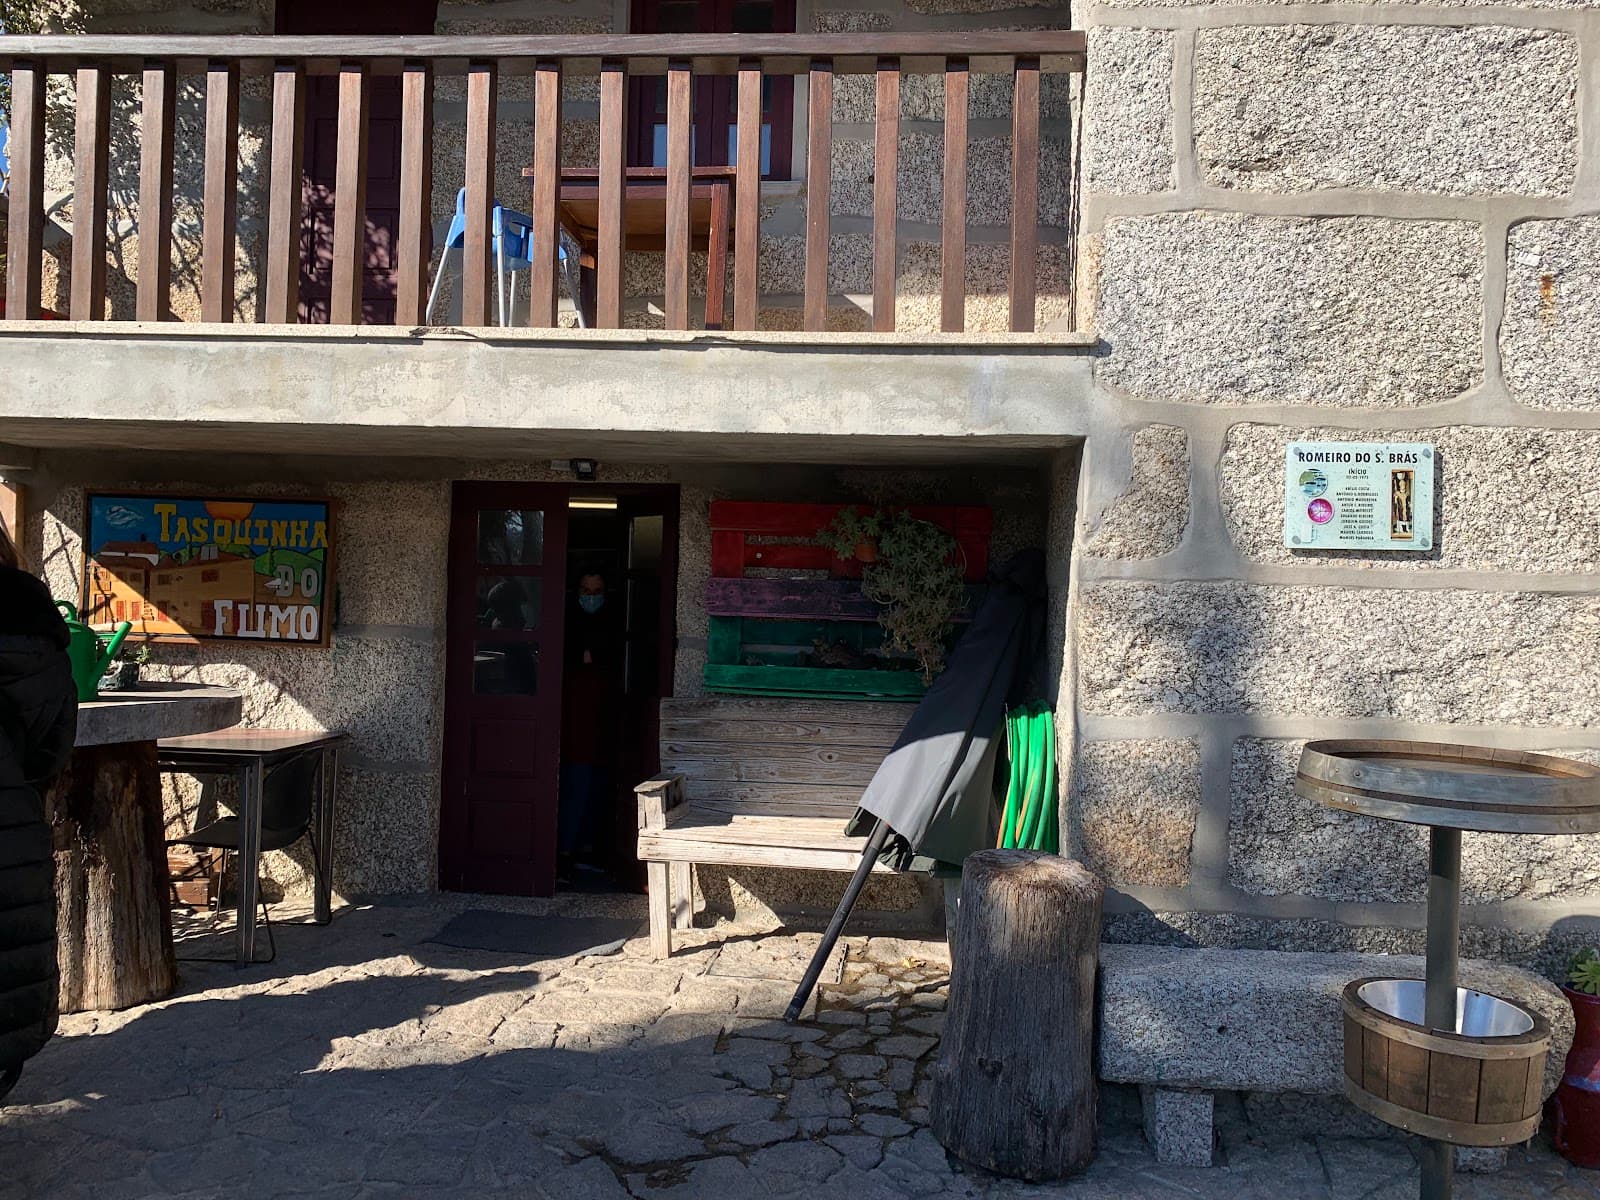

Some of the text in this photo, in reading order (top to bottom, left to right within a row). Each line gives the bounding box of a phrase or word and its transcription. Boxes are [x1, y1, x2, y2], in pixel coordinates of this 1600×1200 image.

[1298, 450, 1418, 464] ROMEIRO DO S. BRÁS
[153, 503, 329, 548] TASQUINHA
[274, 564, 319, 598] DO
